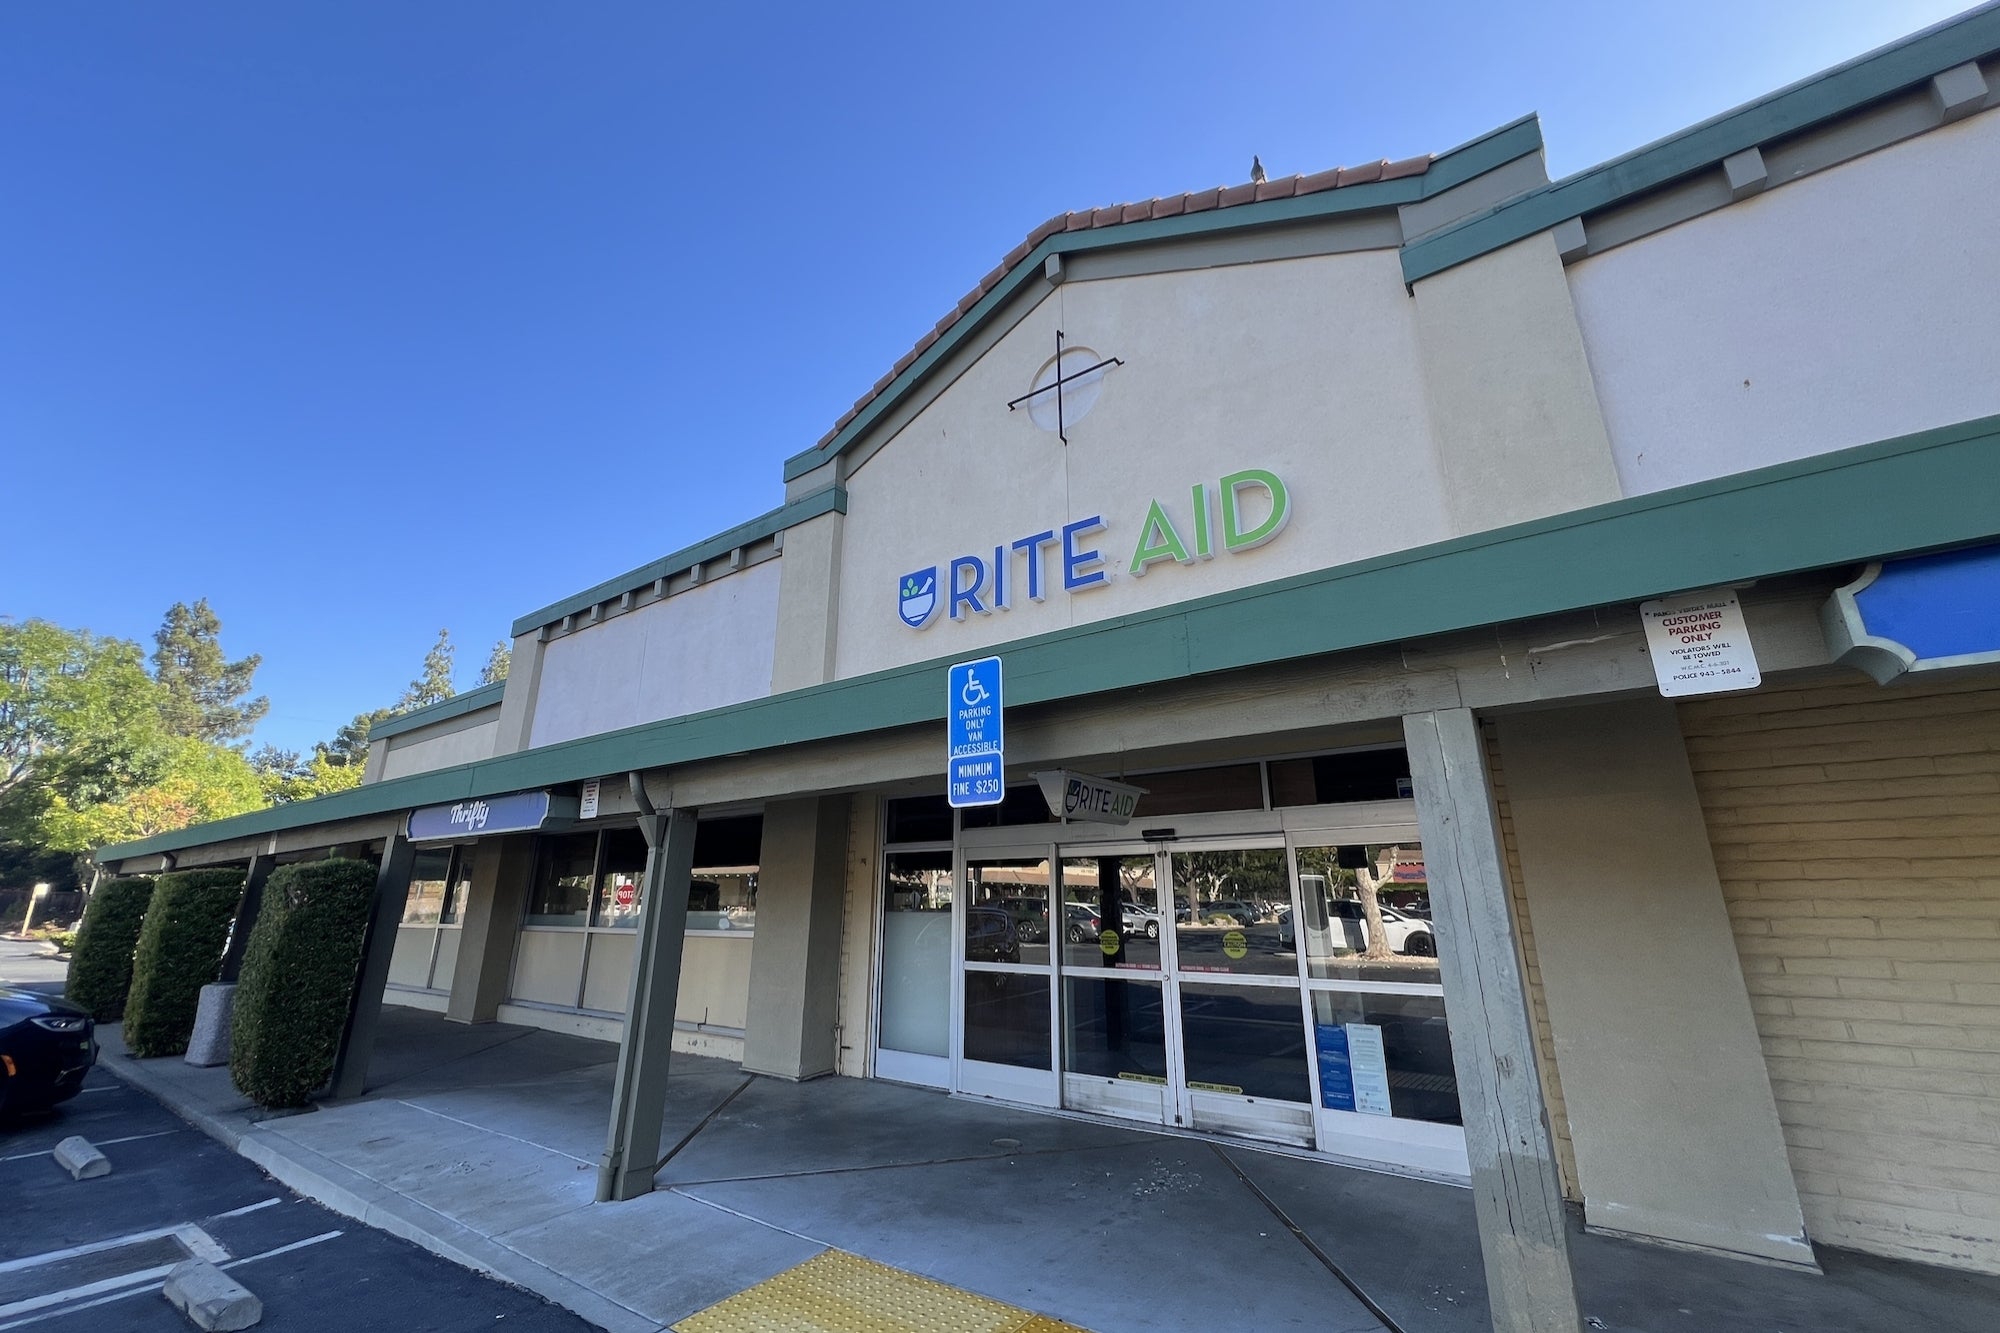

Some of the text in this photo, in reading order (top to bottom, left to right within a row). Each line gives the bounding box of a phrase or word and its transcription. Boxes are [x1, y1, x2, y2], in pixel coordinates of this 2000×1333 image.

[949, 468, 1291, 622] RITE AID
[1663, 611, 1722, 627] CUSTOMER
[1668, 621, 1721, 636] PARKING
[1681, 633, 1712, 644] ONLY
[1670, 642, 1732, 655] VIOLATORS WILL
[1694, 650, 1721, 659] TOWED
[1673, 672, 1698, 681] POLICE
[959, 705, 992, 720] PARKING
[965, 718, 985, 730] ONLY
[968, 731, 983, 742] VAN
[953, 740, 998, 755] ACCESSIBLE
[958, 762, 993, 778] MINIMUM
[953, 778, 999, 796] FINE $250
[1079, 785, 1134, 816] RITE AID
[450, 800, 490, 831] Thrifty
